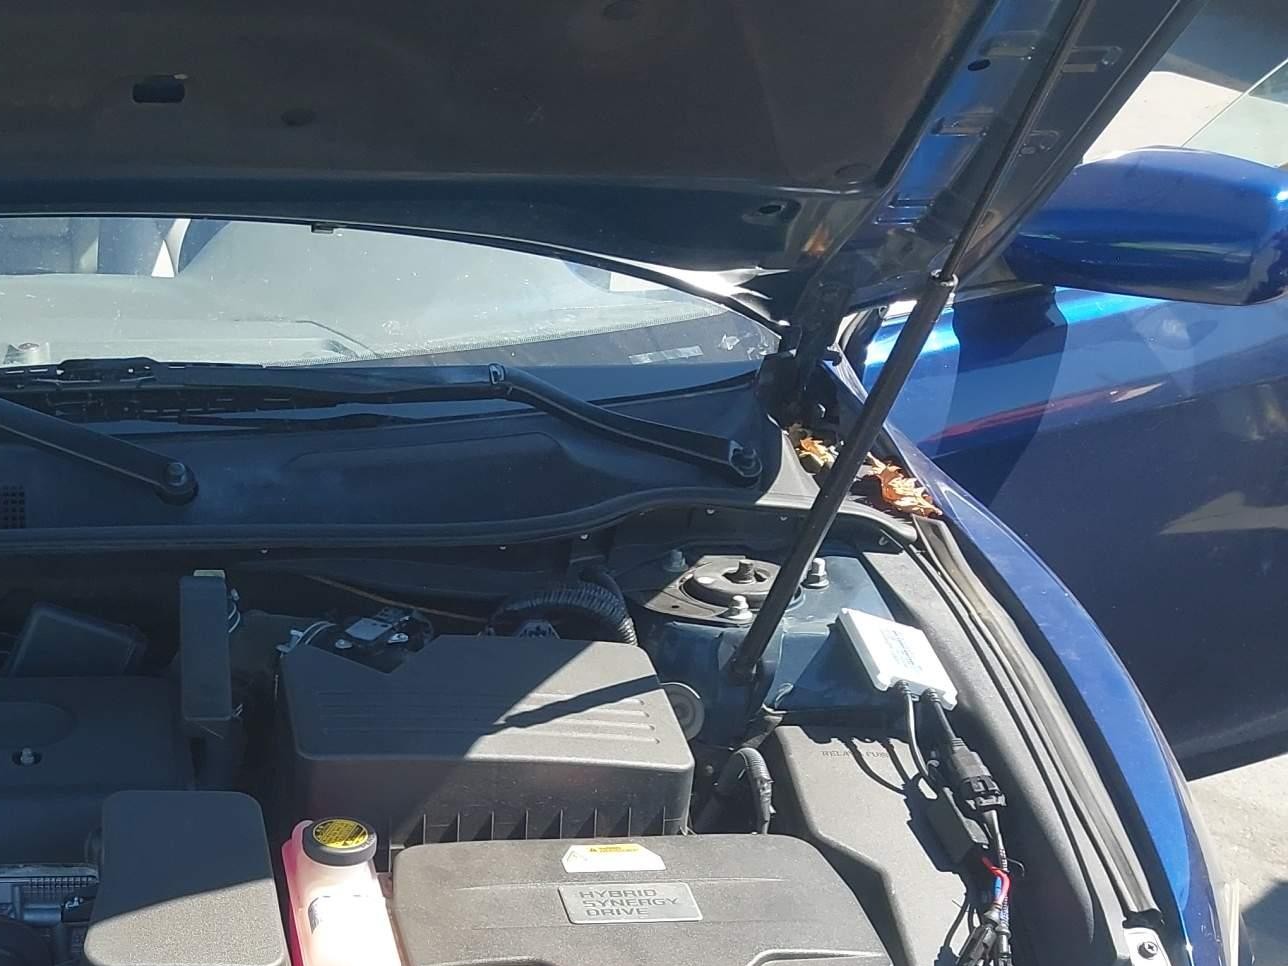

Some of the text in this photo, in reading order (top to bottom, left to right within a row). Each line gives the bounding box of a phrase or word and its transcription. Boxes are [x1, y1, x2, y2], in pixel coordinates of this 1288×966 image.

[579, 889, 657, 898] HYBRID
[582, 897, 680, 908] SYNERGY
[586, 908, 649, 917] DRIVE
